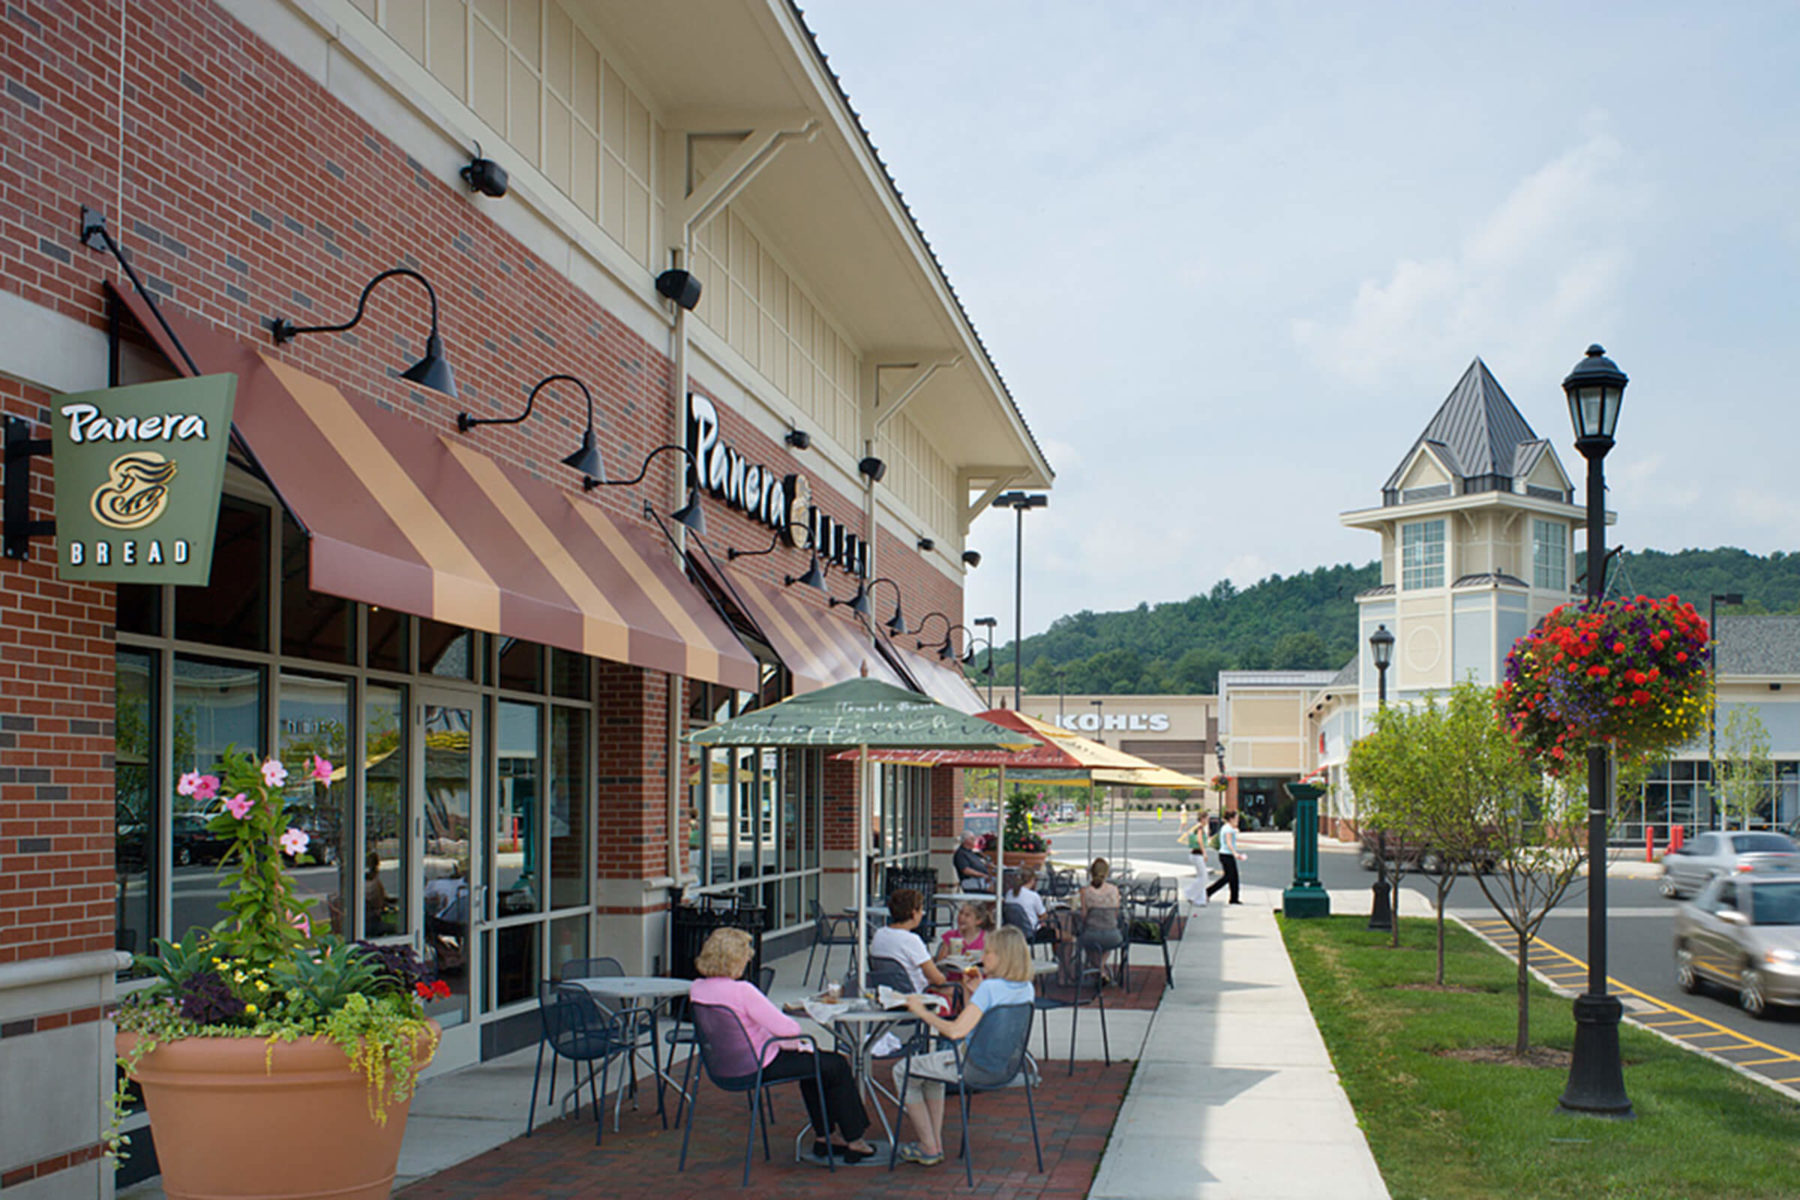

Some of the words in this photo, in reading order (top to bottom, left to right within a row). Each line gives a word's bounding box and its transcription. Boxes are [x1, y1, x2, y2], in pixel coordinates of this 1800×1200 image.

[61, 403, 208, 443] Panera
[688, 392, 787, 529] Panera
[70, 539, 189, 565] BREAD
[1055, 713, 1170, 732] KOHL'S
